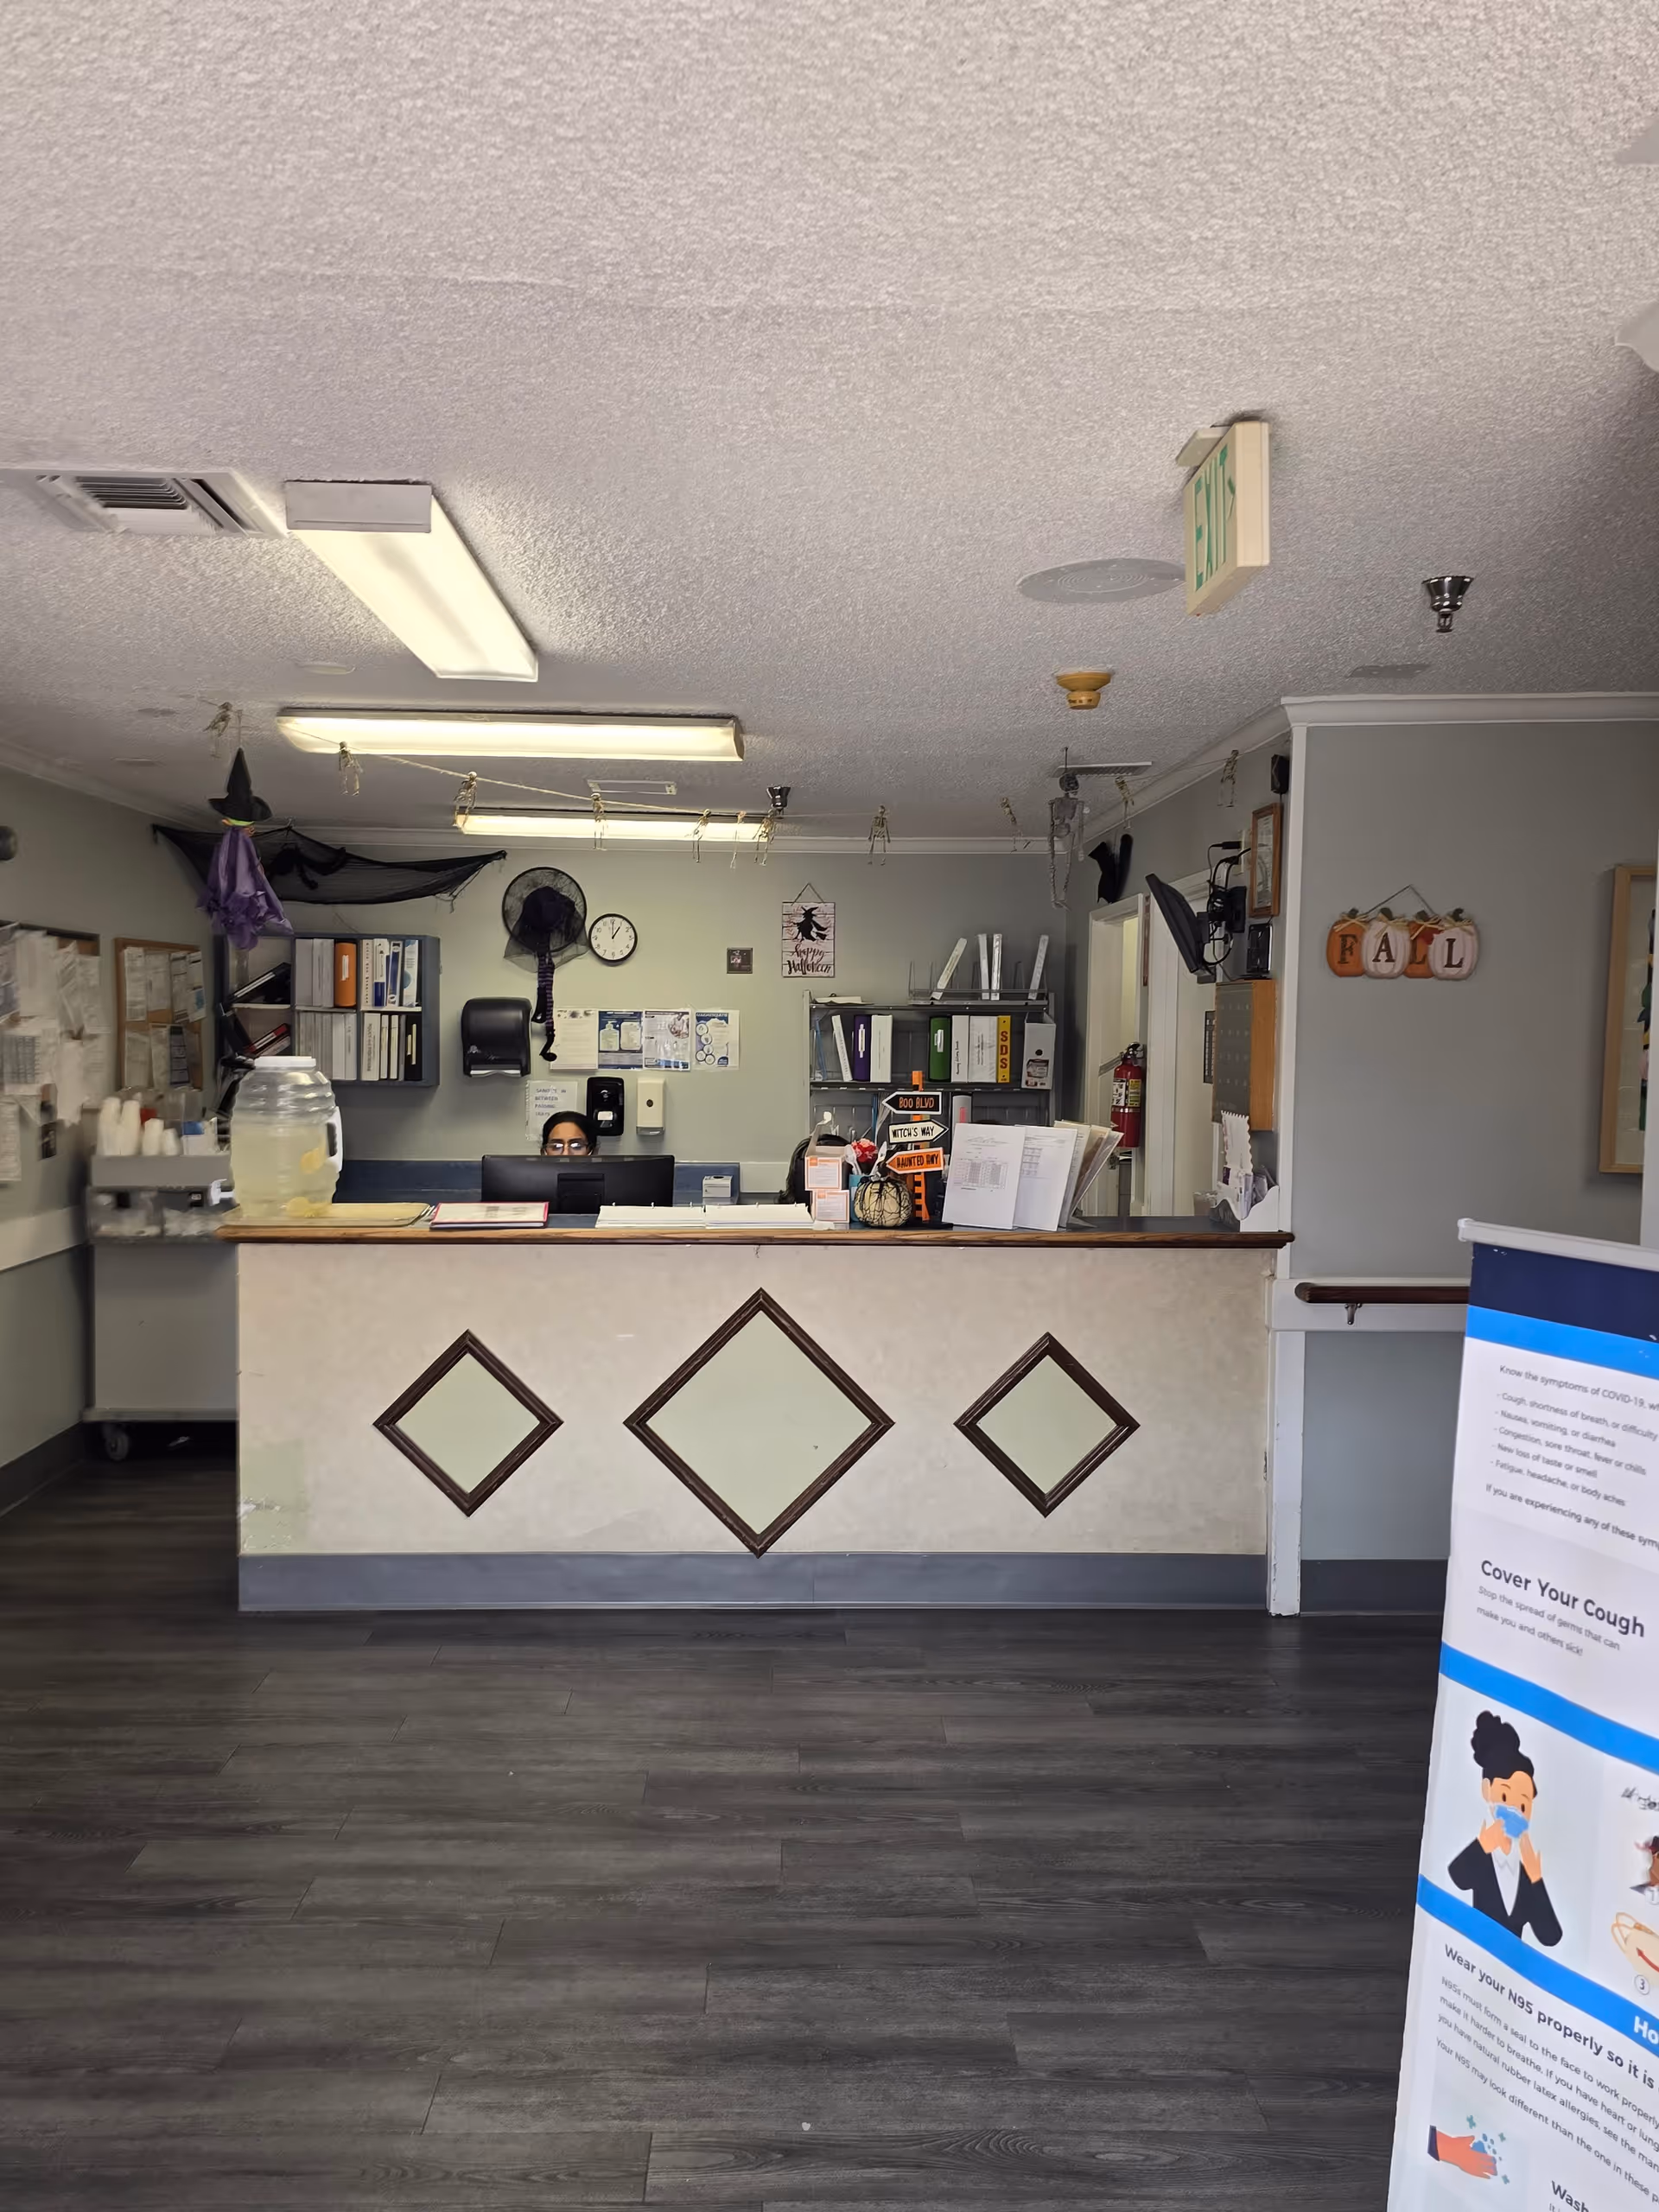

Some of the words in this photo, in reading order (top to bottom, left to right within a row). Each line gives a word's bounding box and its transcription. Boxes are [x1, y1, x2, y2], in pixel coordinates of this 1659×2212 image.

[790, 943, 824, 965] happy
[1338, 931, 1464, 969] FALL
[1000, 1030, 1008, 1069] SDS
[899, 1096, 913, 1109] BOO
[916, 1096, 935, 1109] BLVD
[892, 1127, 918, 1138] WITCH'S
[921, 1126, 935, 1136] WAY
[896, 1154, 925, 1169] HAUNTED
[1500, 1365, 1522, 1377] Know
[1525, 1370, 1538, 1382] the
[1540, 1376, 1588, 1394] symptoms
[1590, 1387, 1601, 1395] of
[1529, 1399, 1568, 1417] shortness
[1570, 1409, 1580, 1418] of
[1611, 1421, 1620, 1429] or
[1621, 1422, 1659, 1442] difficulty
[1571, 1428, 1580, 1438] or
[1582, 1431, 1616, 1448] diarrhea
[1497, 1443, 1514, 1454] New
[1516, 1447, 1530, 1459] loss
[1531, 1453, 1541, 1462] of
[1542, 1456, 1562, 1468] taste
[1575, 1466, 1598, 1478] smell
[1545, 1440, 1562, 1451] sore
[1594, 1452, 1613, 1465] fever
[1614, 1459, 1624, 1468] or
[1485, 1483, 1492, 1492] If
[1493, 1486, 1507, 1497] you
[1510, 1492, 1522, 1503] are
[1524, 1497, 1582, 1522] experiencing
[1584, 1516, 1599, 1529] any
[1600, 1522, 1611, 1531] of
[1611, 1525, 1636, 1541] these
[1570, 1483, 1580, 1491] or
[1581, 1484, 1601, 1500] body
[1603, 1494, 1625, 1506] aches
[1481, 1560, 1532, 1591] Cover
[1537, 1578, 1580, 1610] Your
[1583, 1599, 1645, 1637] Cough
[1477, 1605, 1499, 1621] make
[1500, 1615, 1516, 1628] you
[1518, 1623, 1535, 1636] and
[1537, 1630, 1563, 1648] others
[1478, 1586, 1497, 1600] Stop
[1499, 1594, 1513, 1606] the
[1516, 1601, 1545, 1618] spread
[1547, 1613, 1557, 1622] of
[1557, 1618, 1582, 1635] germs
[1584, 1628, 1602, 1643] that
[1603, 1638, 1620, 1650] can
[1640, 1979, 1645, 1991] 3
[1445, 1943, 1476, 1974] Wear
[1478, 1969, 1505, 1994] your
[1509, 1988, 1533, 2015] N95
[1538, 2011, 1603, 2056] properly
[1607, 2050, 1624, 2068] so
[1628, 2059, 1639, 2079] it
[1643, 2069, 1655, 2089] is
[1441, 1976, 1461, 1996] N95s
[1463, 1993, 1482, 2012] must
[1484, 2006, 1502, 2026] form
[1510, 2028, 1527, 2044] seal
[1529, 2039, 1539, 2050] to
[1541, 2046, 1558, 2062] the
[1560, 2056, 1581, 2075] face
[1583, 2070, 1593, 2082] to
[1596, 2078, 1619, 2100] work
[1438, 2013, 1452, 2028] you
[1453, 2023, 1471, 2043] have
[1473, 2039, 1500, 2064] natural
[1502, 2061, 1532, 2087] rubber
[1533, 2080, 1557, 2101] latex
[1603, 2125, 1618, 2142] see
[1621, 2138, 1636, 2155] the
[1440, 1996, 1461, 2016] make
[1463, 2010, 1469, 2021] it
[1471, 2016, 1496, 2040] harder
[1497, 2037, 1505, 2048] to
[1506, 2043, 1543, 2074] breathe.
[1546, 2069, 1554, 2079] If
[1555, 2075, 1573, 2091] you
[1575, 2085, 1599, 2107] have
[1600, 2101, 1625, 2126] heart
[1627, 2122, 1637, 2134] or
[1436, 2037, 1454, 2056] Your
[1455, 2051, 1471, 2069] N95
[1471, 2066, 1488, 2084] may
[1490, 2078, 1507, 2098] look
[1509, 2094, 1548, 2125] different
[1552, 2120, 1573, 2140] than
[1576, 2135, 1592, 2152] the
[1593, 2149, 1611, 2167] one
[1613, 2162, 1622, 2175] in
[1624, 2171, 1649, 2196] these
